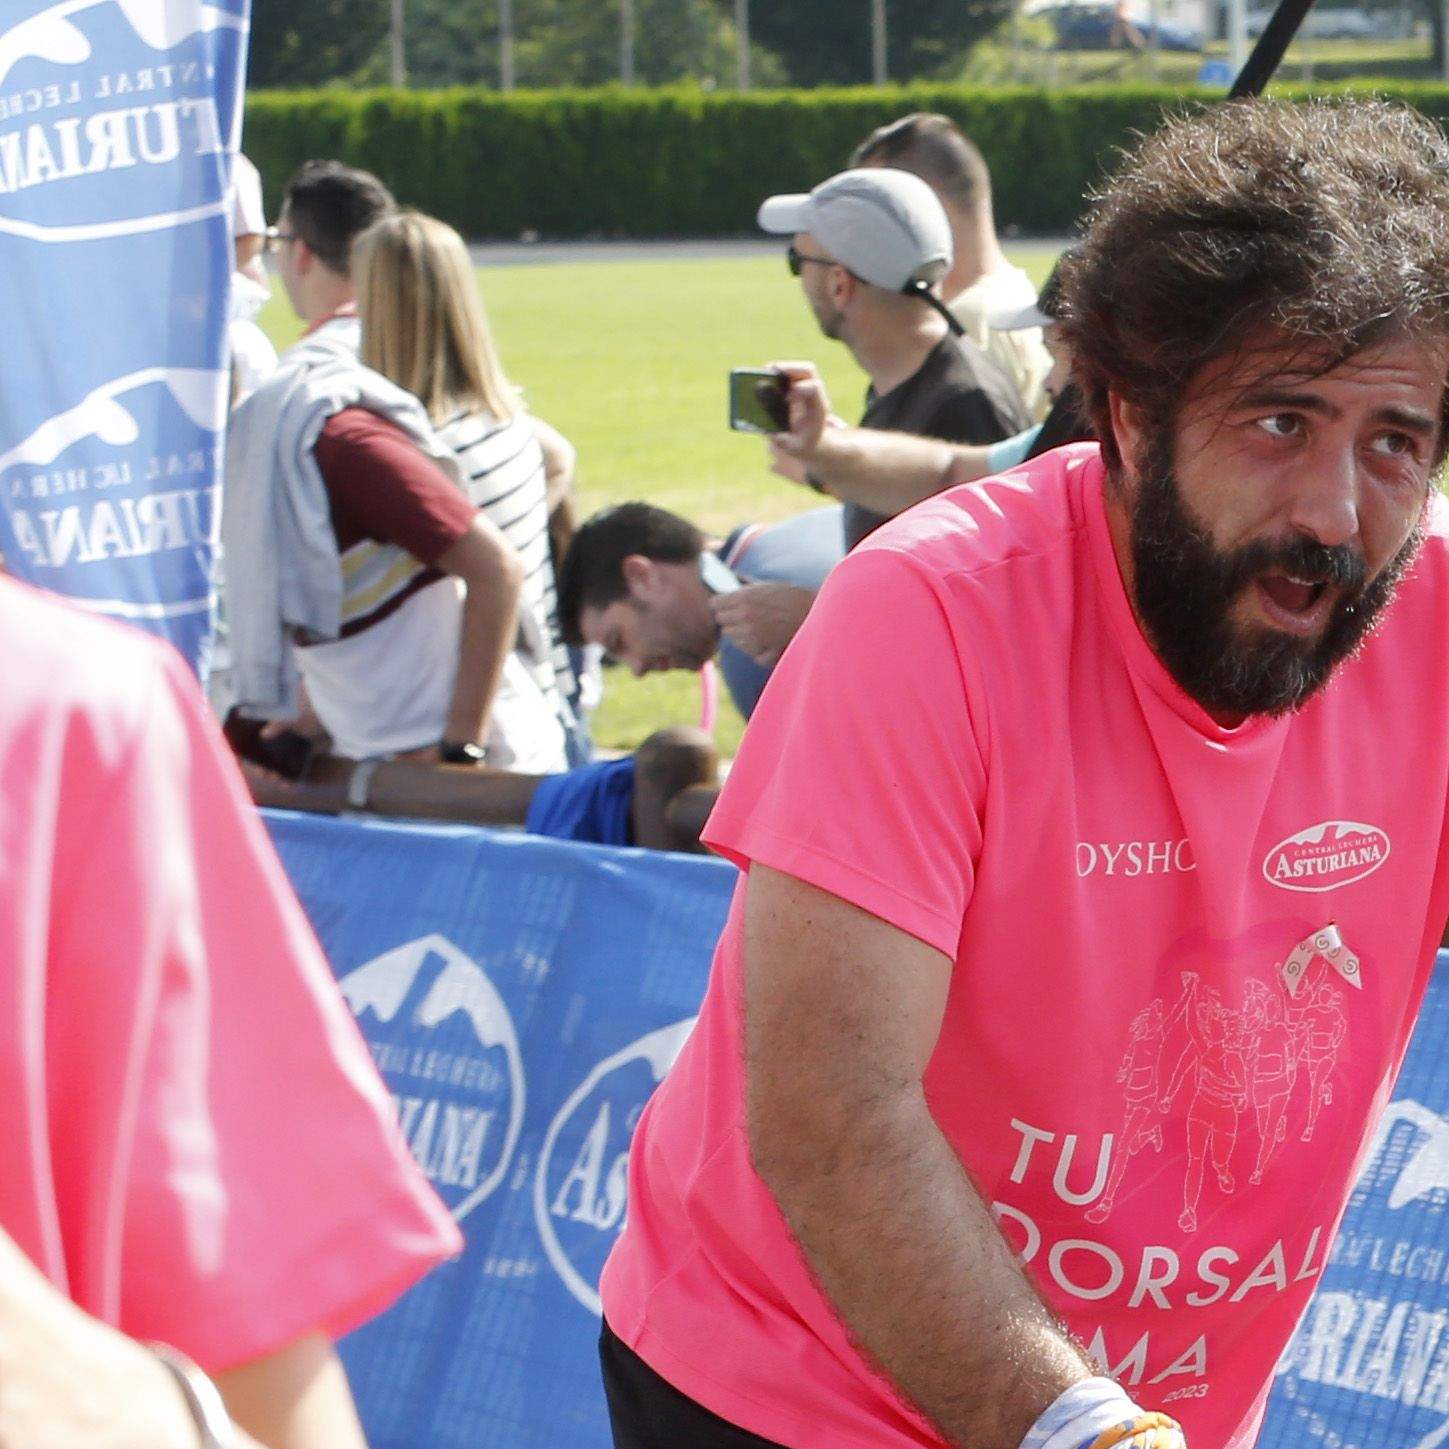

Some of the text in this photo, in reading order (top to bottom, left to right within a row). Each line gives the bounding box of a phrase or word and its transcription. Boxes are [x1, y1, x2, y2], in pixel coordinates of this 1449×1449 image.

[1274, 844, 1381, 880] ASTURIANA
[1010, 1118, 1114, 1205] TU
[1086, 1325, 1207, 1386] MA
